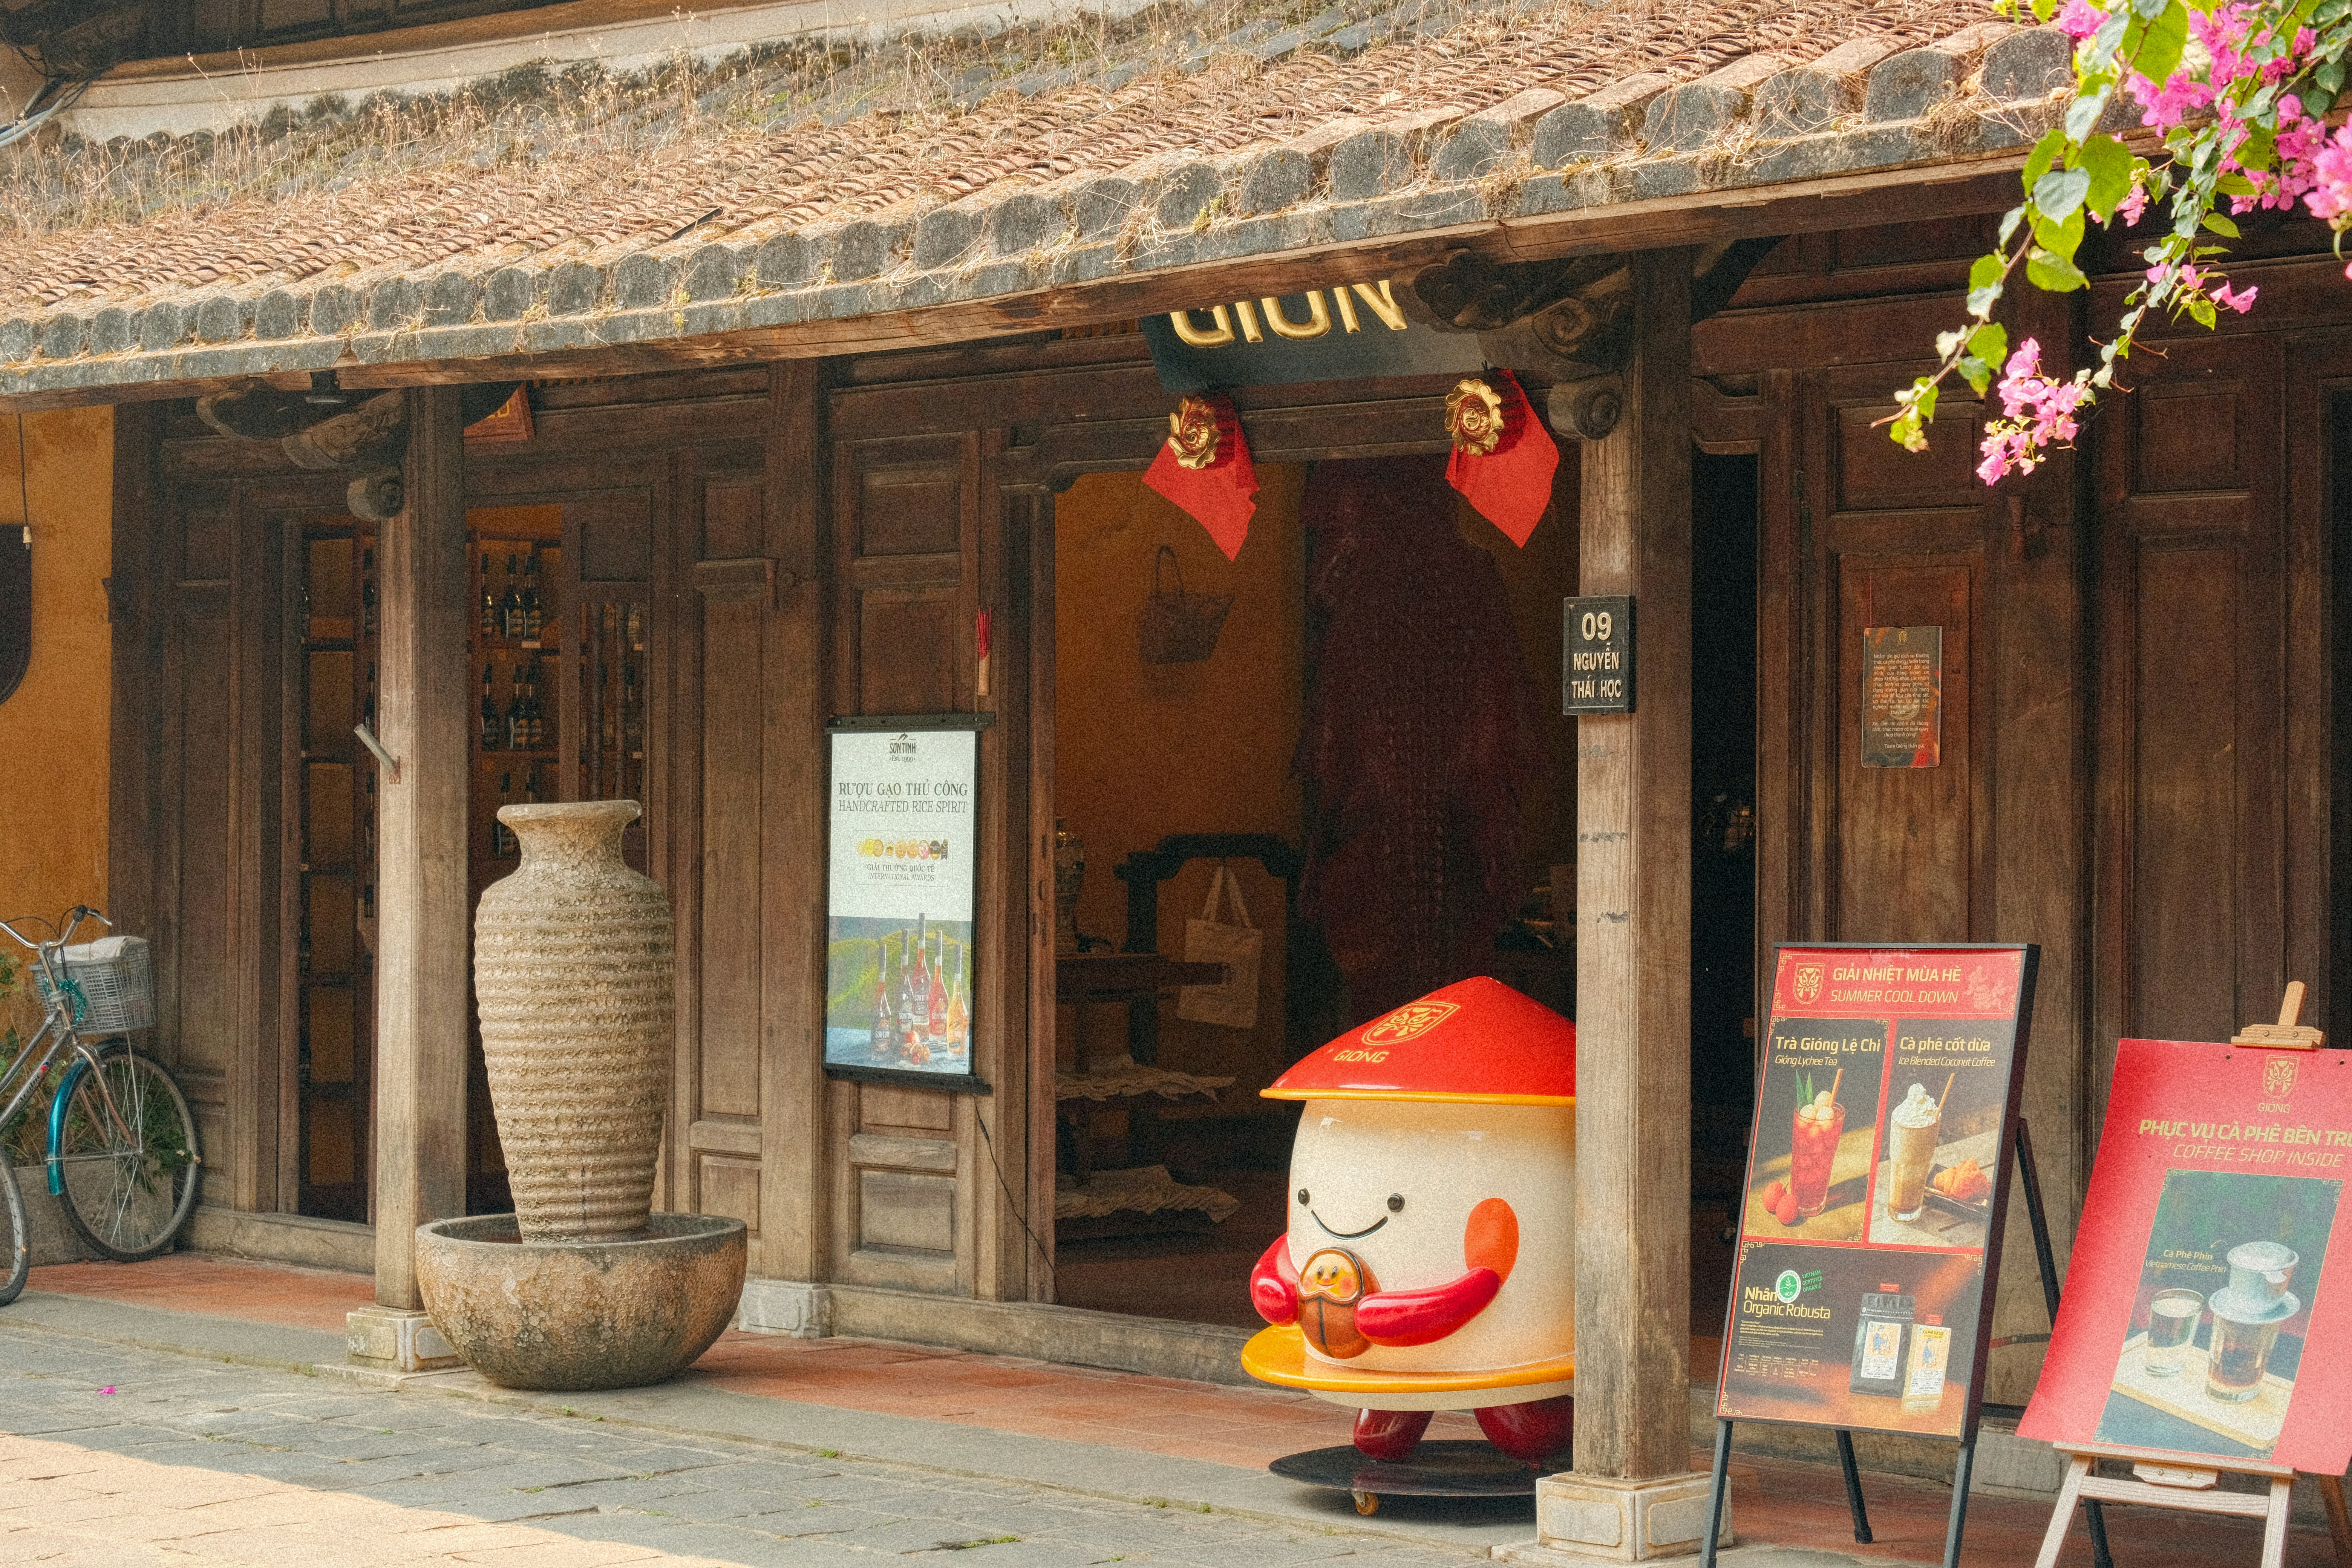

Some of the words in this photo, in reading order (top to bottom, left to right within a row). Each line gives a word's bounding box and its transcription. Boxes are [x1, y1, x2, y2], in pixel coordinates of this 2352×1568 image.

[1582, 612, 1611, 640] 09
[1573, 642, 1620, 670] NGUYỄN
[1571, 675, 1595, 698] THÁI
[1600, 680, 1622, 703] HỌC
[839, 783, 874, 798] RƯỢU
[877, 783, 902, 798] GẠO
[906, 779, 930, 796] THỦ
[934, 780, 968, 796] CÔNG
[839, 800, 909, 812] HANDCRAFTED
[912, 801, 934, 812] RICE
[936, 801, 968, 813] SPIRIT
[1833, 963, 1861, 981] GIẢI
[1862, 967, 1903, 986] NHIỆT
[1906, 966, 1939, 982] MÙA
[1942, 965, 1961, 982] HÈ
[1830, 990, 1881, 1003] SUMMER
[1885, 991, 1915, 1003] COOL
[1918, 992, 1958, 1004] DOWN
[1776, 1036, 1797, 1050] Trà
[1801, 1036, 1838, 1055] Gióng
[1842, 1038, 1857, 1055] Lệ
[1860, 1038, 1880, 1052] Chi
[1900, 1036, 1915, 1050] Cà
[1918, 1037, 1942, 1053] phê
[1945, 1035, 1965, 1051] cốt
[1968, 1037, 1990, 1051] dừa
[1333, 1048, 1390, 1063] GIÓNG
[1775, 1055, 1797, 1067] Gióng
[1798, 1057, 1823, 1067] Lychee
[1825, 1057, 1838, 1066] Tea
[1911, 1057, 1940, 1066] Blended
[1941, 1057, 1972, 1066] Coconut
[1972, 1057, 1995, 1067] Coffee
[2258, 1101, 2291, 1113] GIÓNG
[2139, 1119, 2188, 1140] PHỤC
[2191, 1122, 2216, 1142] VỤ
[2218, 1121, 2240, 1140] CÀ
[2243, 1123, 2283, 1143] PHÊ
[2283, 1124, 2321, 1145] BÊN
[2173, 1144, 2236, 1161] COFFEE
[2238, 1148, 2285, 1164] SHOP
[2288, 1151, 2344, 1168] INSIDE
[2163, 1249, 2173, 1258] Cà
[2176, 1250, 2191, 1259] Phê
[2193, 1252, 2213, 1260] Phin
[2145, 1259, 2186, 1270] Vietnamese
[2187, 1262, 2210, 1272] Coffee
[2210, 1264, 2226, 1273] Phin
[1802, 1269, 1821, 1279] VIETNAM
[1802, 1275, 1823, 1285] CERTIFIED
[1745, 1286, 1778, 1302] Nhân
[1803, 1283, 1822, 1292] ORGANIC
[1743, 1300, 1785, 1318] Organic
[1786, 1303, 1830, 1319] Robusta
